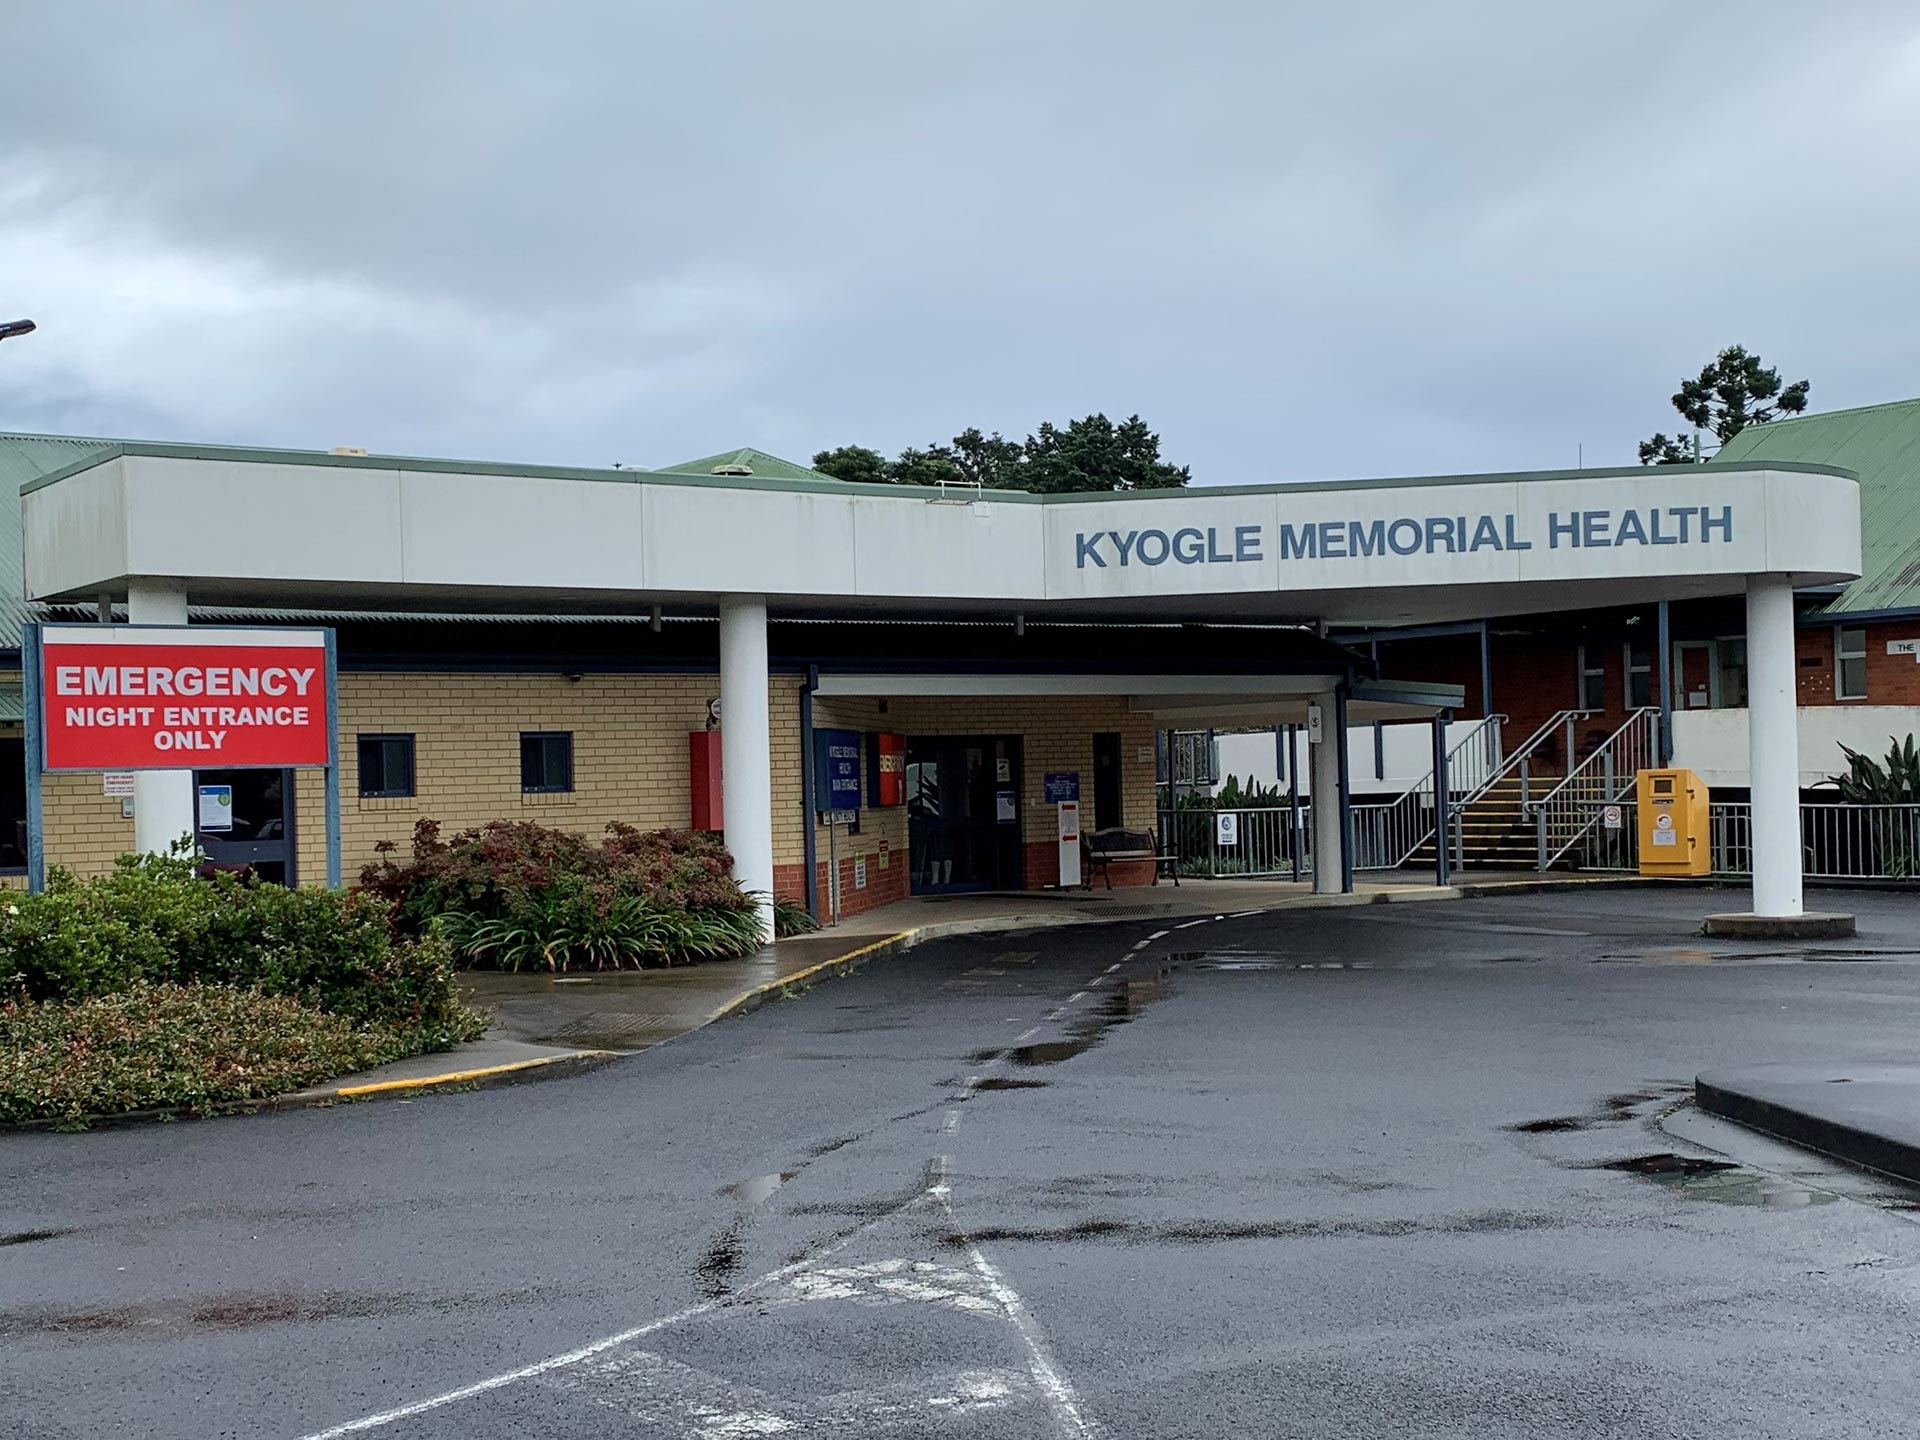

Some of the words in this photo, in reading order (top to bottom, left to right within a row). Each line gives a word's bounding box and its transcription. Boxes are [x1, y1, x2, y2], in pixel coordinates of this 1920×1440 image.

[1075, 525, 1263, 569] KYOGLE
[1280, 514, 1532, 560] MEMORIAL
[1549, 506, 1733, 549] HEALTH
[1898, 643, 1915, 652] THE
[56, 666, 315, 697] EMERGENCY
[65, 706, 154, 727] NIGHT
[164, 706, 309, 726] ENTRANCE
[154, 730, 227, 750] ONLY
